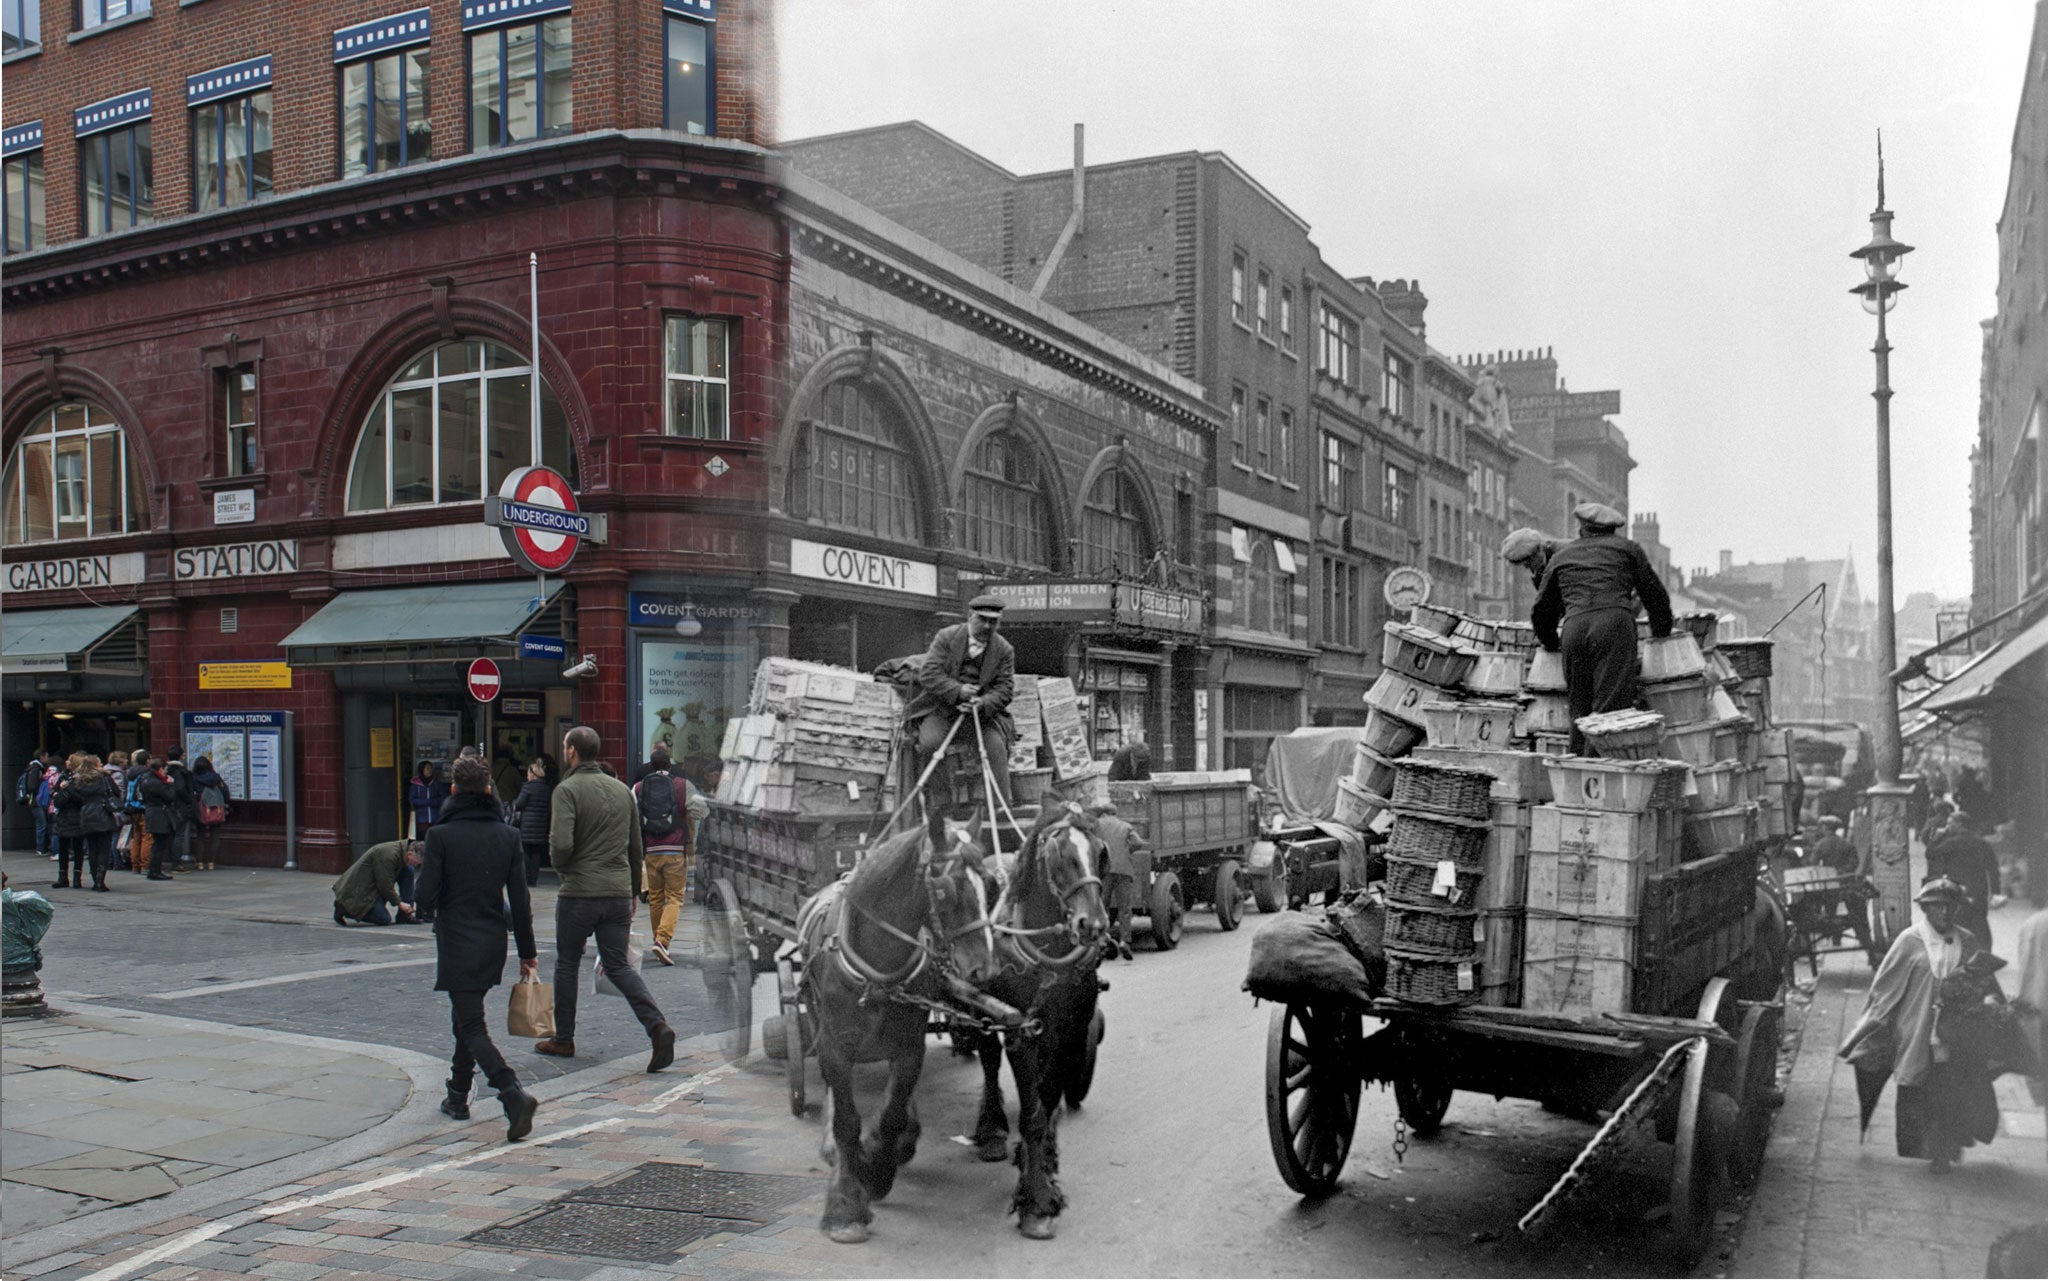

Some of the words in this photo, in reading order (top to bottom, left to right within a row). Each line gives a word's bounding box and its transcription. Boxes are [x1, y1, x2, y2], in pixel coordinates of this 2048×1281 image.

[216, 494, 237, 504] JAMES
[216, 503, 237, 514] STREET
[503, 504, 587, 533] UNDERGROUND
[176, 540, 299, 579] STATION
[9, 556, 112, 591] GARDEN
[823, 547, 911, 589] COVENT
[990, 585, 1042, 597] COVENT
[1053, 584, 1108, 595] GARDEN
[1019, 596, 1072, 608] STATION
[640, 603, 691, 616] COVENT
[696, 605, 760, 618] GARDEN
[524, 642, 544, 651] COVENT
[544, 644, 563, 653] GARDEN
[1413, 652, 1428, 670] C
[649, 668, 672, 677] Don't
[673, 669, 687, 679] get
[649, 677, 659, 687] by
[660, 677, 675, 686] the
[194, 714, 218, 724] COVENT
[219, 714, 245, 724] GARDEN
[246, 714, 272, 723] STATION
[1478, 719, 1492, 741] C
[1584, 776, 1600, 799] C
